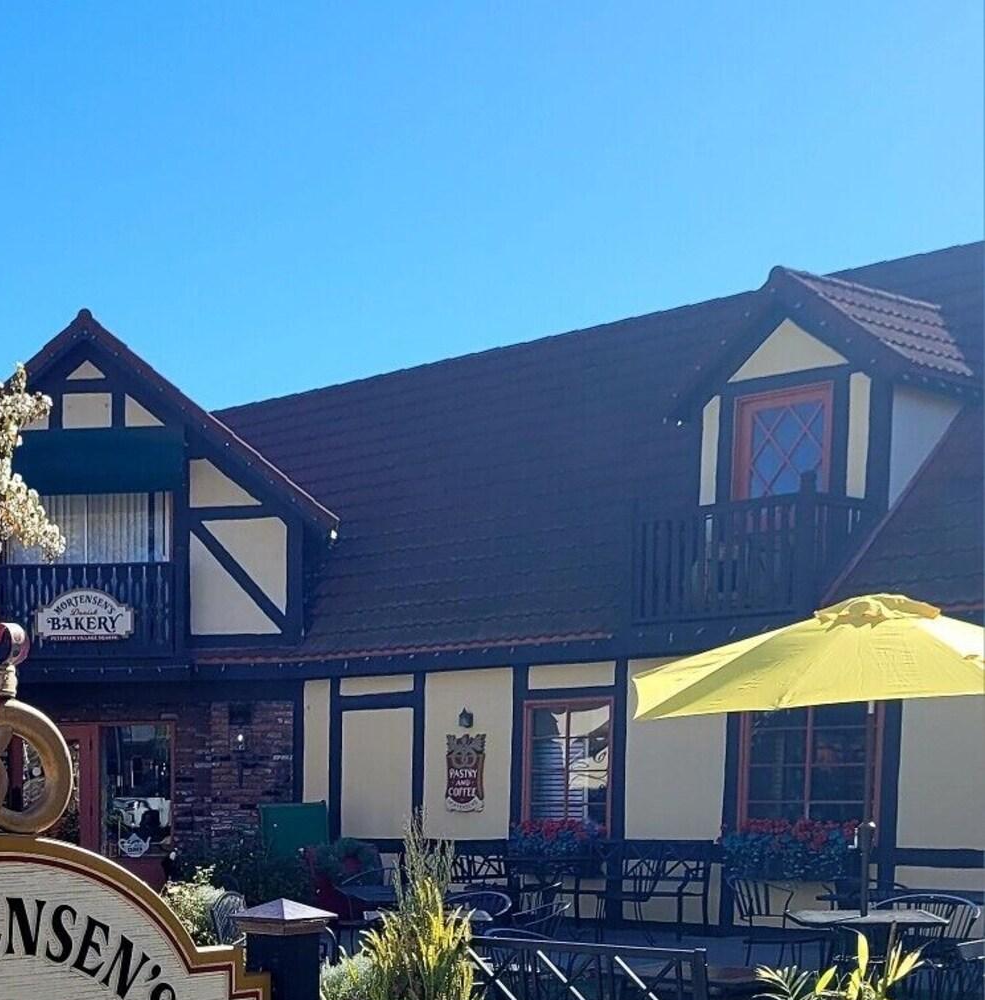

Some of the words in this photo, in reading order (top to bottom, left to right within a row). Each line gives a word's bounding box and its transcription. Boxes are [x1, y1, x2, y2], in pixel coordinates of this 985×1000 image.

[54, 595, 115, 615] MORTENSEN'S
[46, 613, 123, 633] BAKERY
[449, 767, 478, 779] PASTRY
[448, 787, 476, 797] COFFEE
